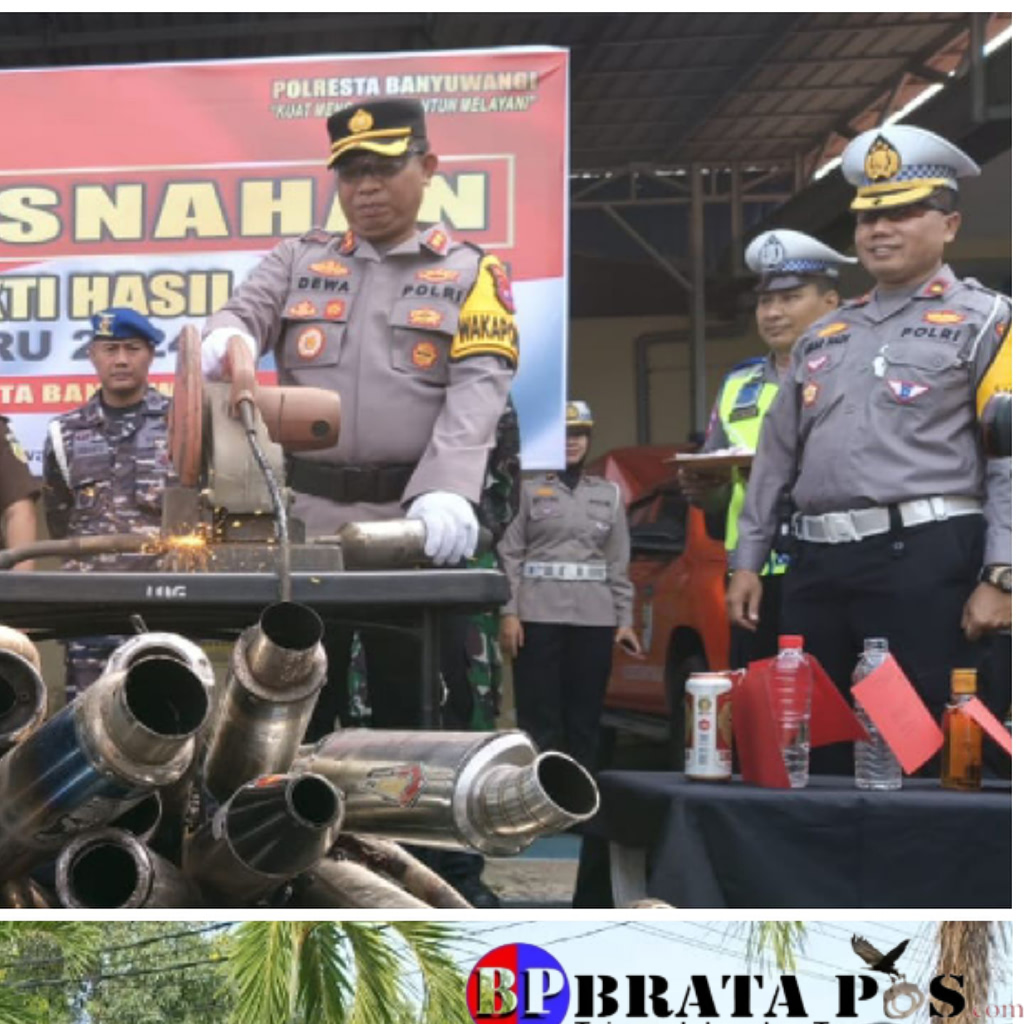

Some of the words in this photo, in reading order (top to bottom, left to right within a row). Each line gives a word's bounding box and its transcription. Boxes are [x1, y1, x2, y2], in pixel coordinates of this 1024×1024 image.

[273, 77, 380, 99] POLRESTA
[386, 72, 538, 94] BANYUWANGI
[298, 276, 350, 293] DEWA
[402, 283, 465, 301] POLRI
[901, 326, 963, 342] POLRI
